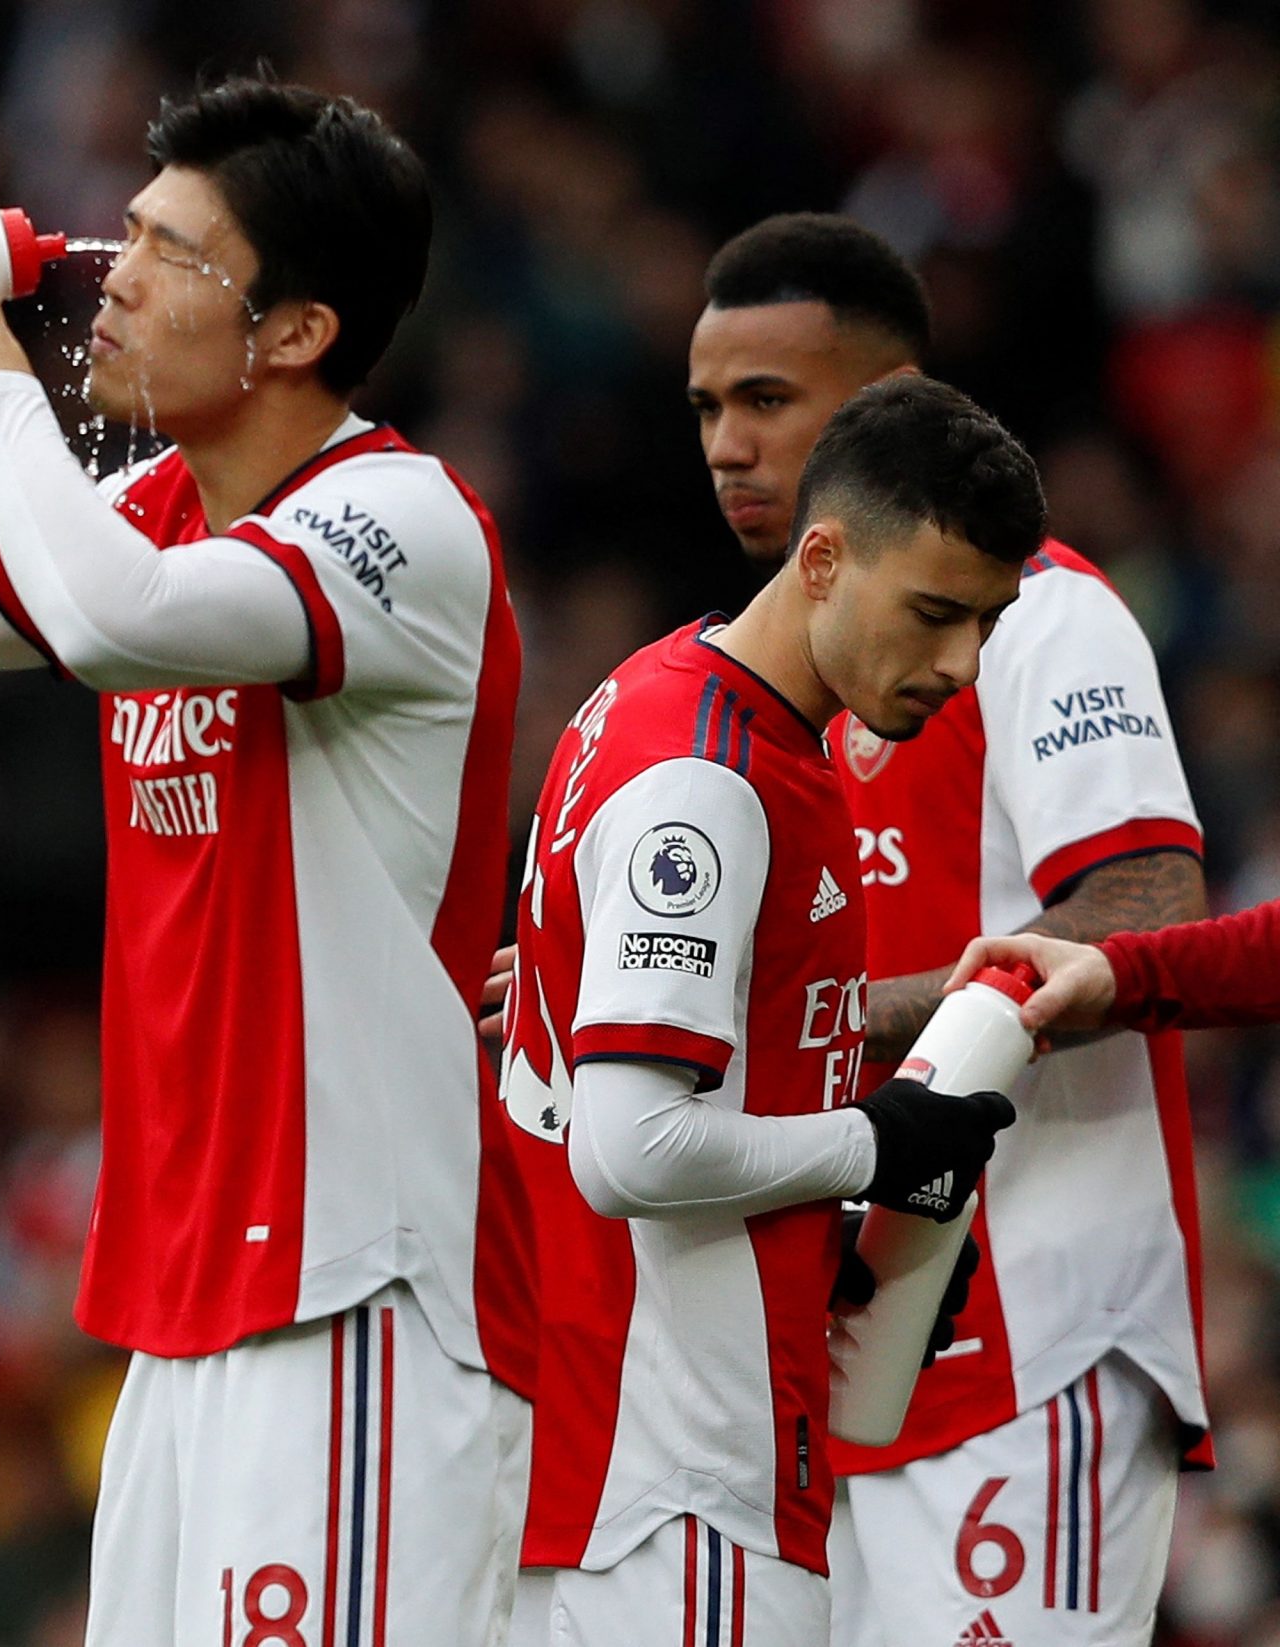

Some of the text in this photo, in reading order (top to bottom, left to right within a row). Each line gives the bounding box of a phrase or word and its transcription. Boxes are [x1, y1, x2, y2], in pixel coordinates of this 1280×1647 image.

[342, 503, 408, 573] VISIT
[1051, 685, 1125, 718] VISIT
[1031, 711, 1162, 762] RWANDA
[666, 872, 711, 909] Premier League
[810, 892, 847, 922] adidas
[620, 951, 712, 977] for racism
[622, 934, 707, 959] No room
[907, 1192, 951, 1212] adidas
[956, 1477, 1026, 1598] 6
[220, 1563, 308, 1647] 18
